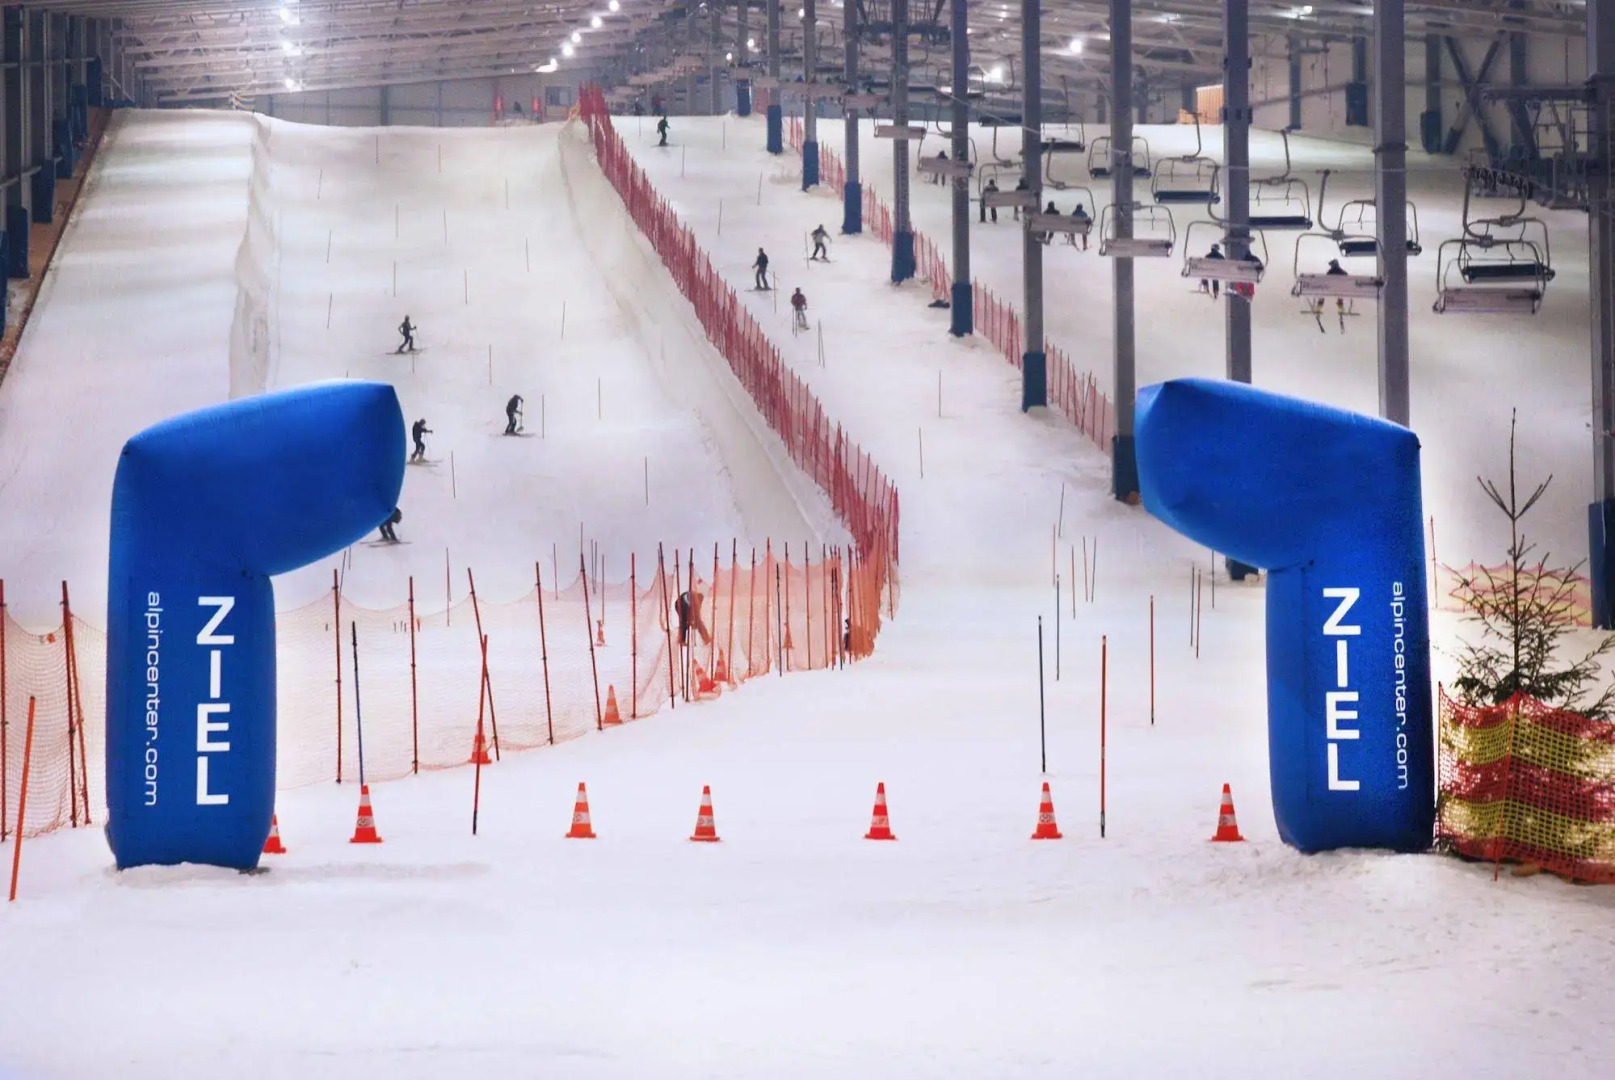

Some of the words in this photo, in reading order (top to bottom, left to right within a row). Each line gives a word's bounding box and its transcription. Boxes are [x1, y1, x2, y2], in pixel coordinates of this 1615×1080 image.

[144, 591, 163, 806] alpincenter.com
[196, 596, 235, 805] ZIEL
[1322, 587, 1362, 791] ZIEL
[1389, 581, 1409, 789] alpincenter.com
